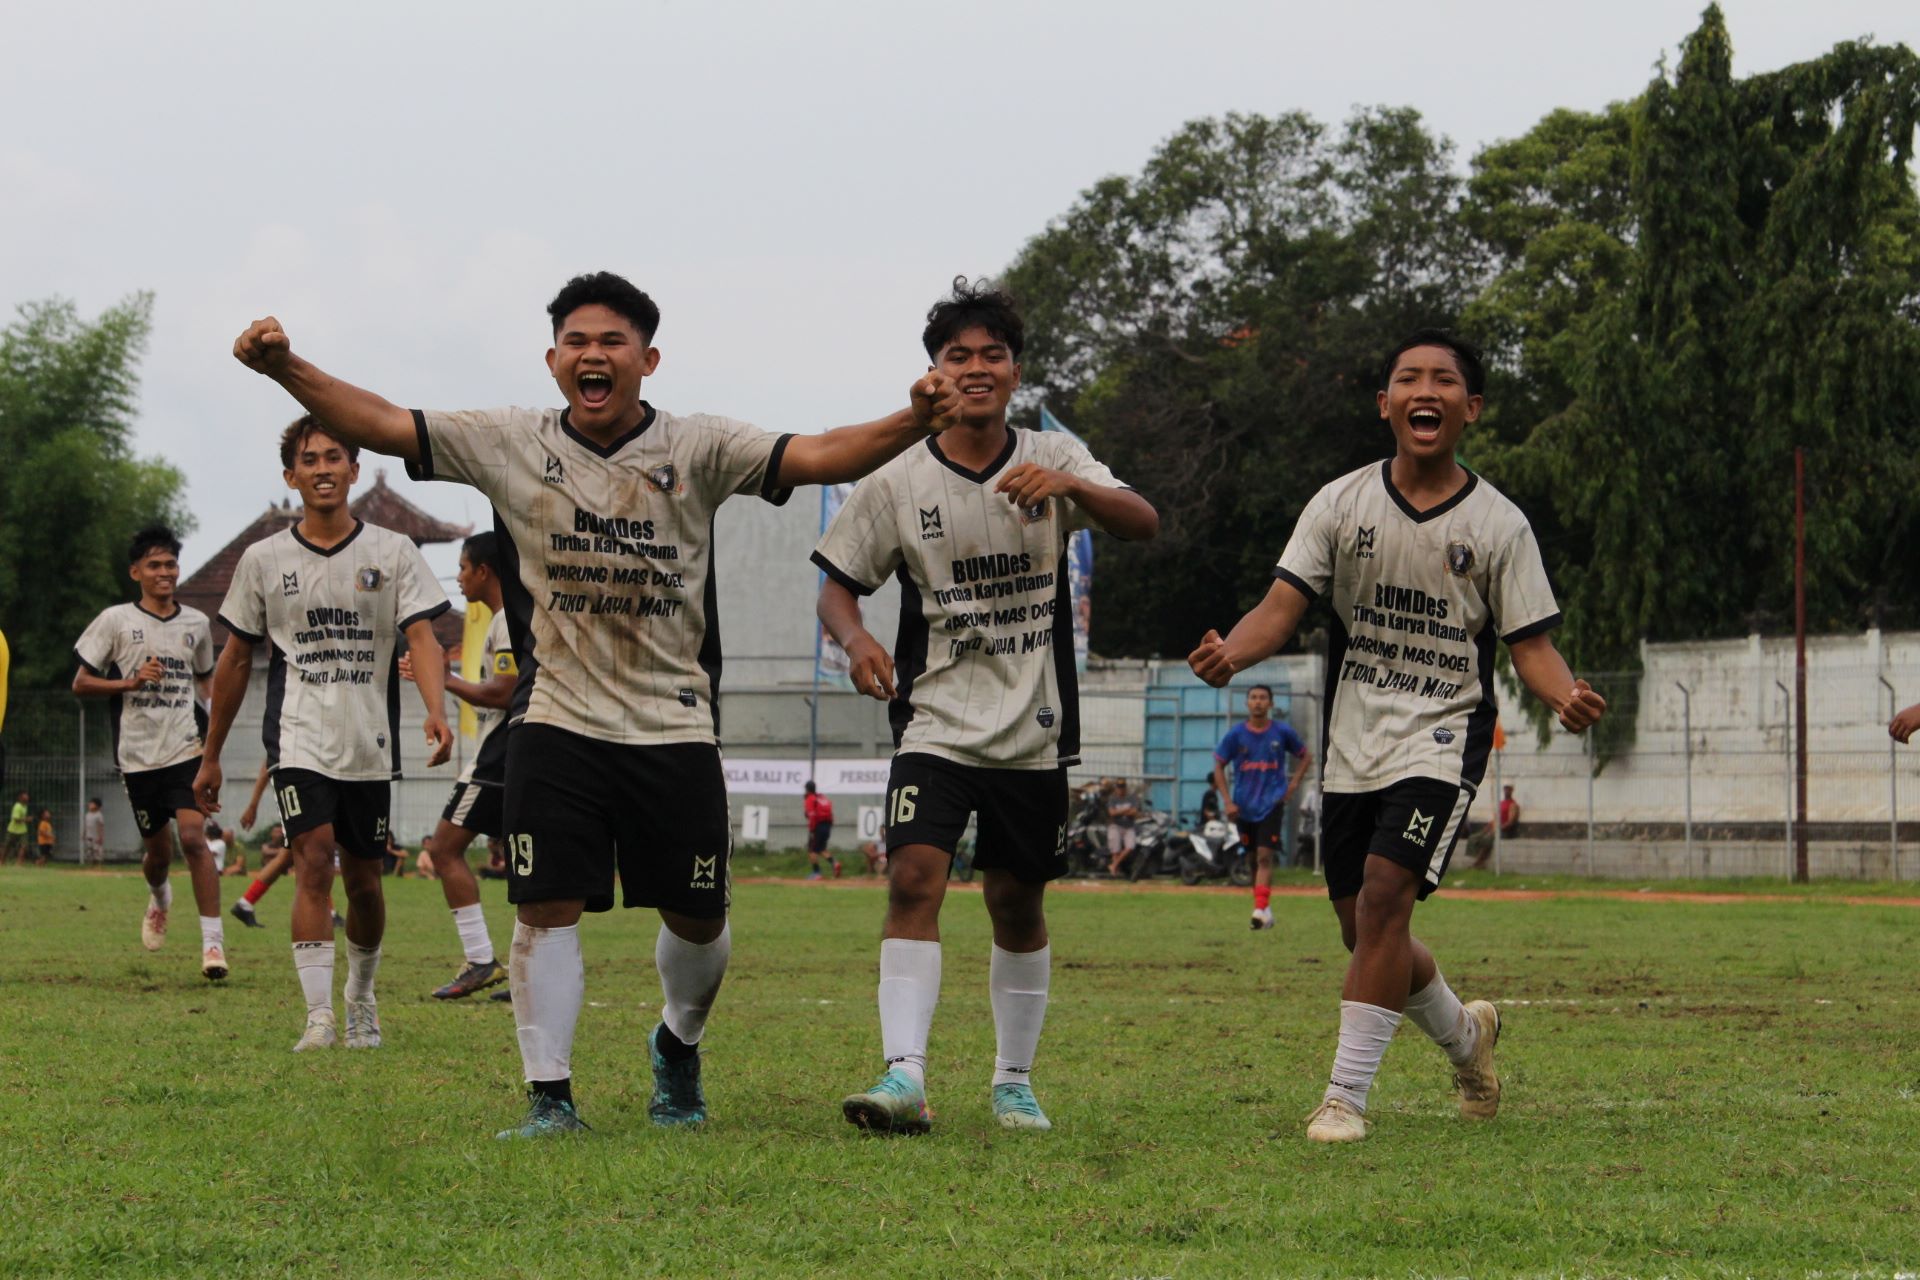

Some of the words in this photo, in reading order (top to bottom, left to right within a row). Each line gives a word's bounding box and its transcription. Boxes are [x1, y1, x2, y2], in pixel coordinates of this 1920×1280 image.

[574, 508, 655, 540] BUMDes
[922, 531, 944, 540] EMJE
[550, 533, 590, 552] Tirtha
[594, 536, 635, 555] Karya
[547, 565, 608, 583] WARUNG
[613, 568, 648, 585] MAS
[652, 570, 685, 588] DOEL
[952, 553, 1031, 584] BUMDes
[933, 586, 972, 606] Tirtha
[975, 580, 1013, 600] Karya
[1015, 572, 1054, 593] Utama
[1374, 582, 1448, 619] BUMDes
[548, 592, 586, 612] TOKO
[590, 594, 632, 614] JAYA
[635, 596, 682, 617] MART
[994, 606, 1026, 625] MAS
[347, 628, 373, 640] Utama
[1388, 612, 1425, 634] Karya
[1428, 619, 1467, 642] Utama
[1402, 645, 1435, 666] MAS
[1438, 653, 1469, 673] DOEL
[300, 669, 328, 684] TOKO
[1342, 660, 1377, 684] TOKO
[1376, 669, 1419, 693] JAYA
[1420, 677, 1463, 699] MART
[753, 771, 781, 783] BALI
[786, 771, 802, 783] FC
[280, 785, 302, 820] 10
[890, 785, 919, 827] 16
[752, 810, 760, 835] 1
[863, 810, 878, 836] 0
[1402, 831, 1426, 847] EMJE
[509, 833, 533, 876] 19
[690, 881, 716, 889] EMJE
